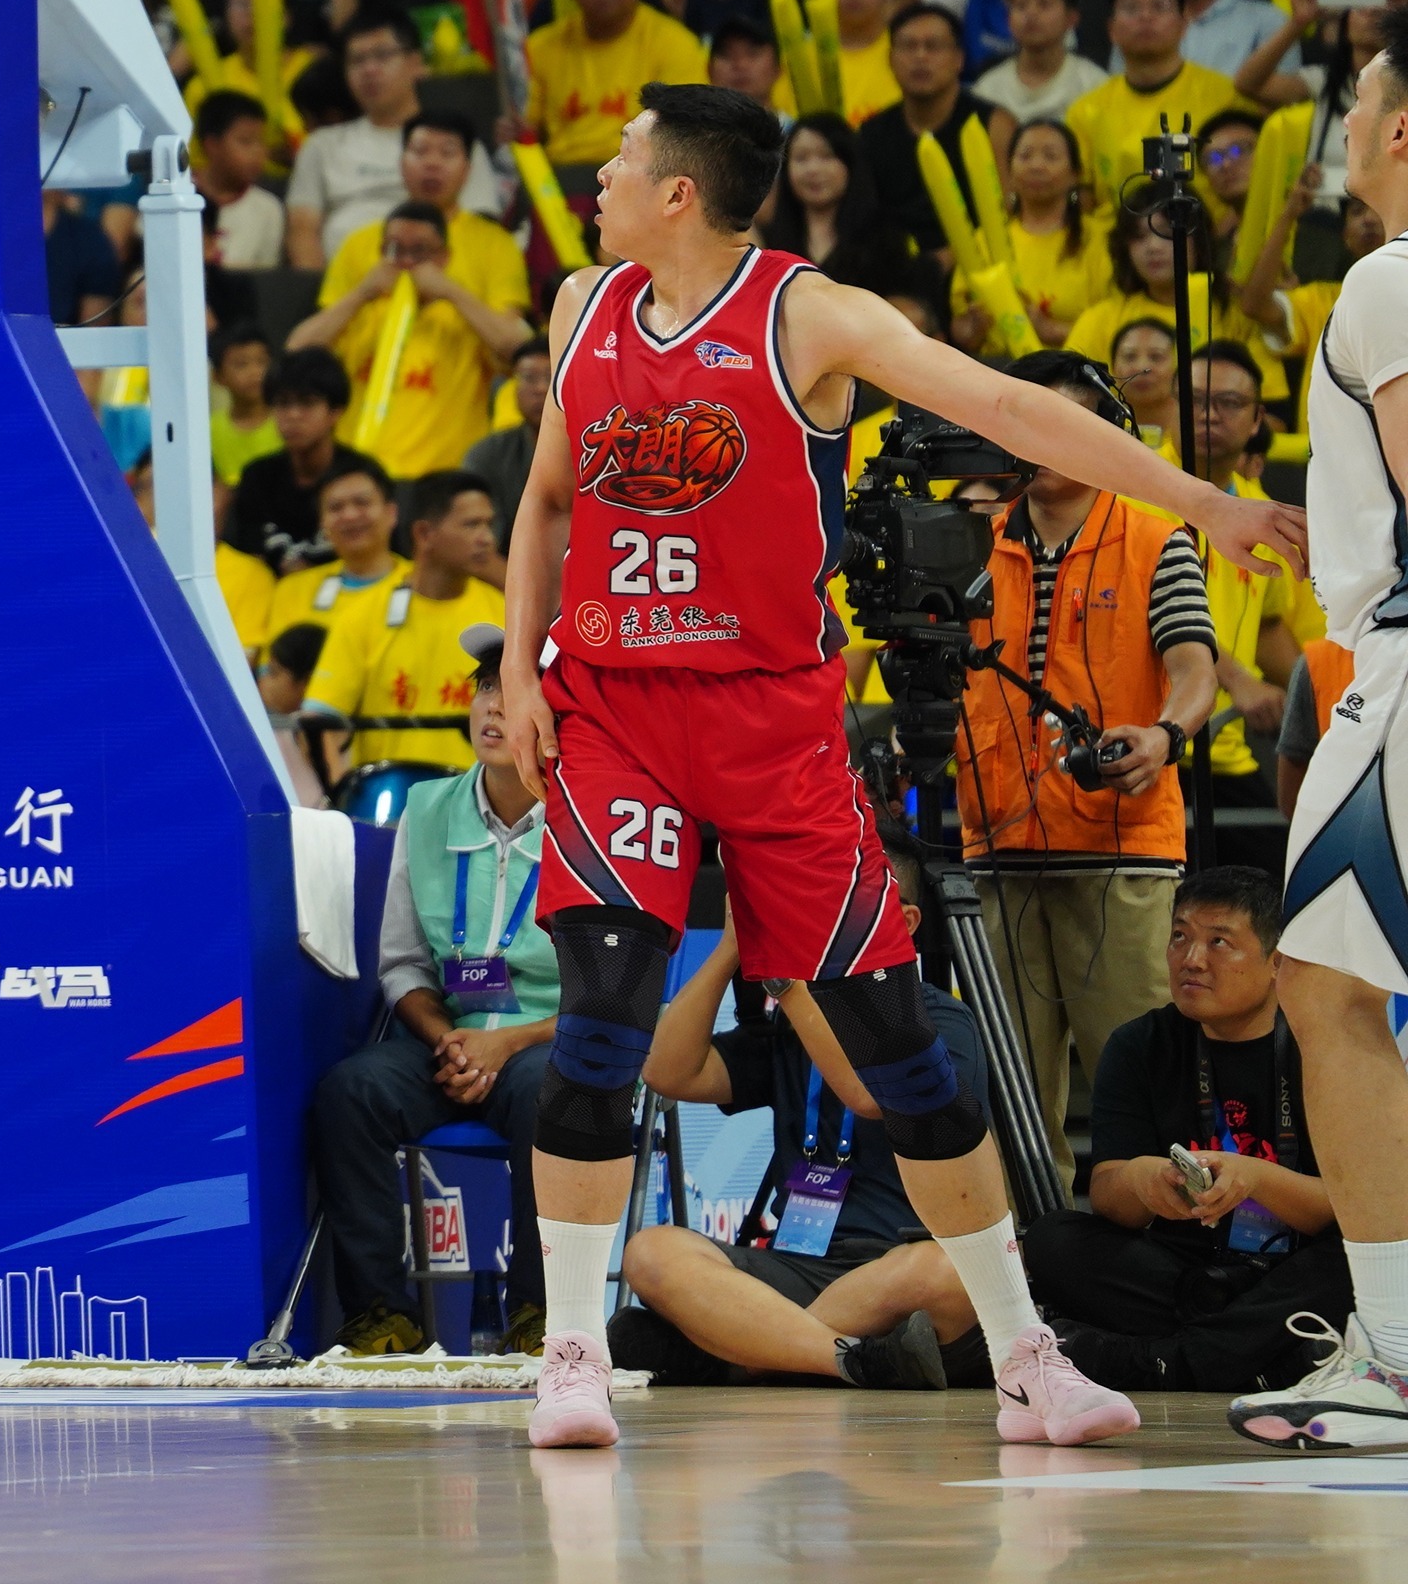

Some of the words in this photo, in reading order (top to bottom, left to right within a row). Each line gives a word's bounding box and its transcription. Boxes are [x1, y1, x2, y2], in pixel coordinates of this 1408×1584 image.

[610, 528, 698, 596] 26
[621, 637, 656, 647] BANK
[656, 634, 673, 644] OF
[674, 630, 740, 642] DONGGUAN
[608, 797, 684, 871] 26
[461, 968, 489, 982] FOP
[68, 998, 86, 1008] WAR
[87, 998, 112, 1008] HORSE
[1280, 1076, 1292, 1127] SONY
[804, 1171, 832, 1185] FOP
